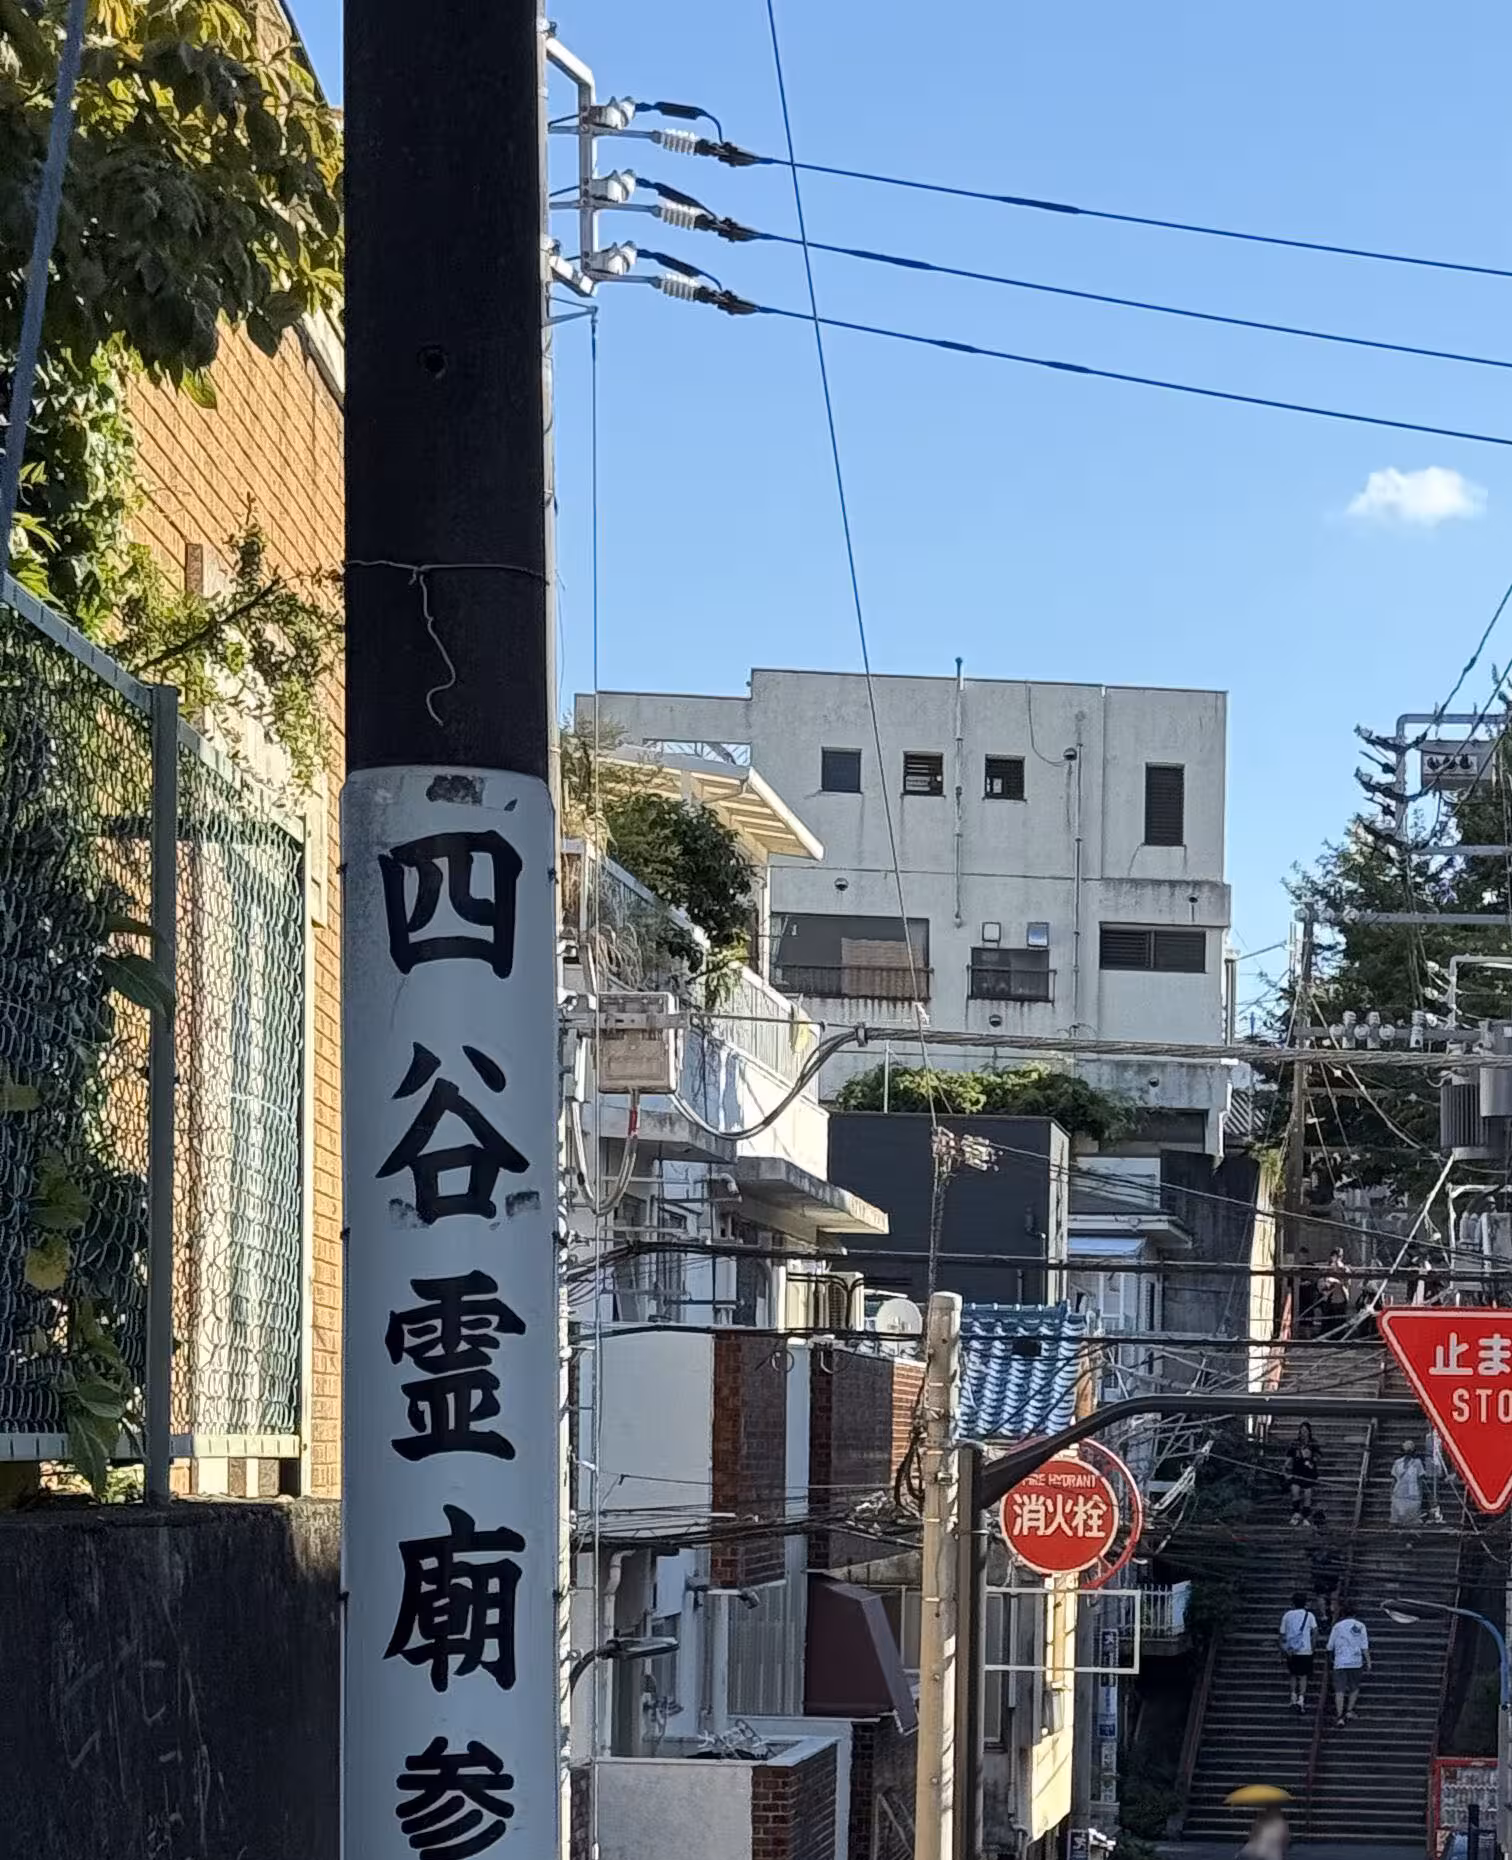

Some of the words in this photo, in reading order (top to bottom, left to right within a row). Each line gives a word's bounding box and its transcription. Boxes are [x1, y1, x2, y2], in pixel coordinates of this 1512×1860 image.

[1048, 1474, 1097, 1488] HYDRANT
[1012, 1493, 1108, 1538] 消火栓
